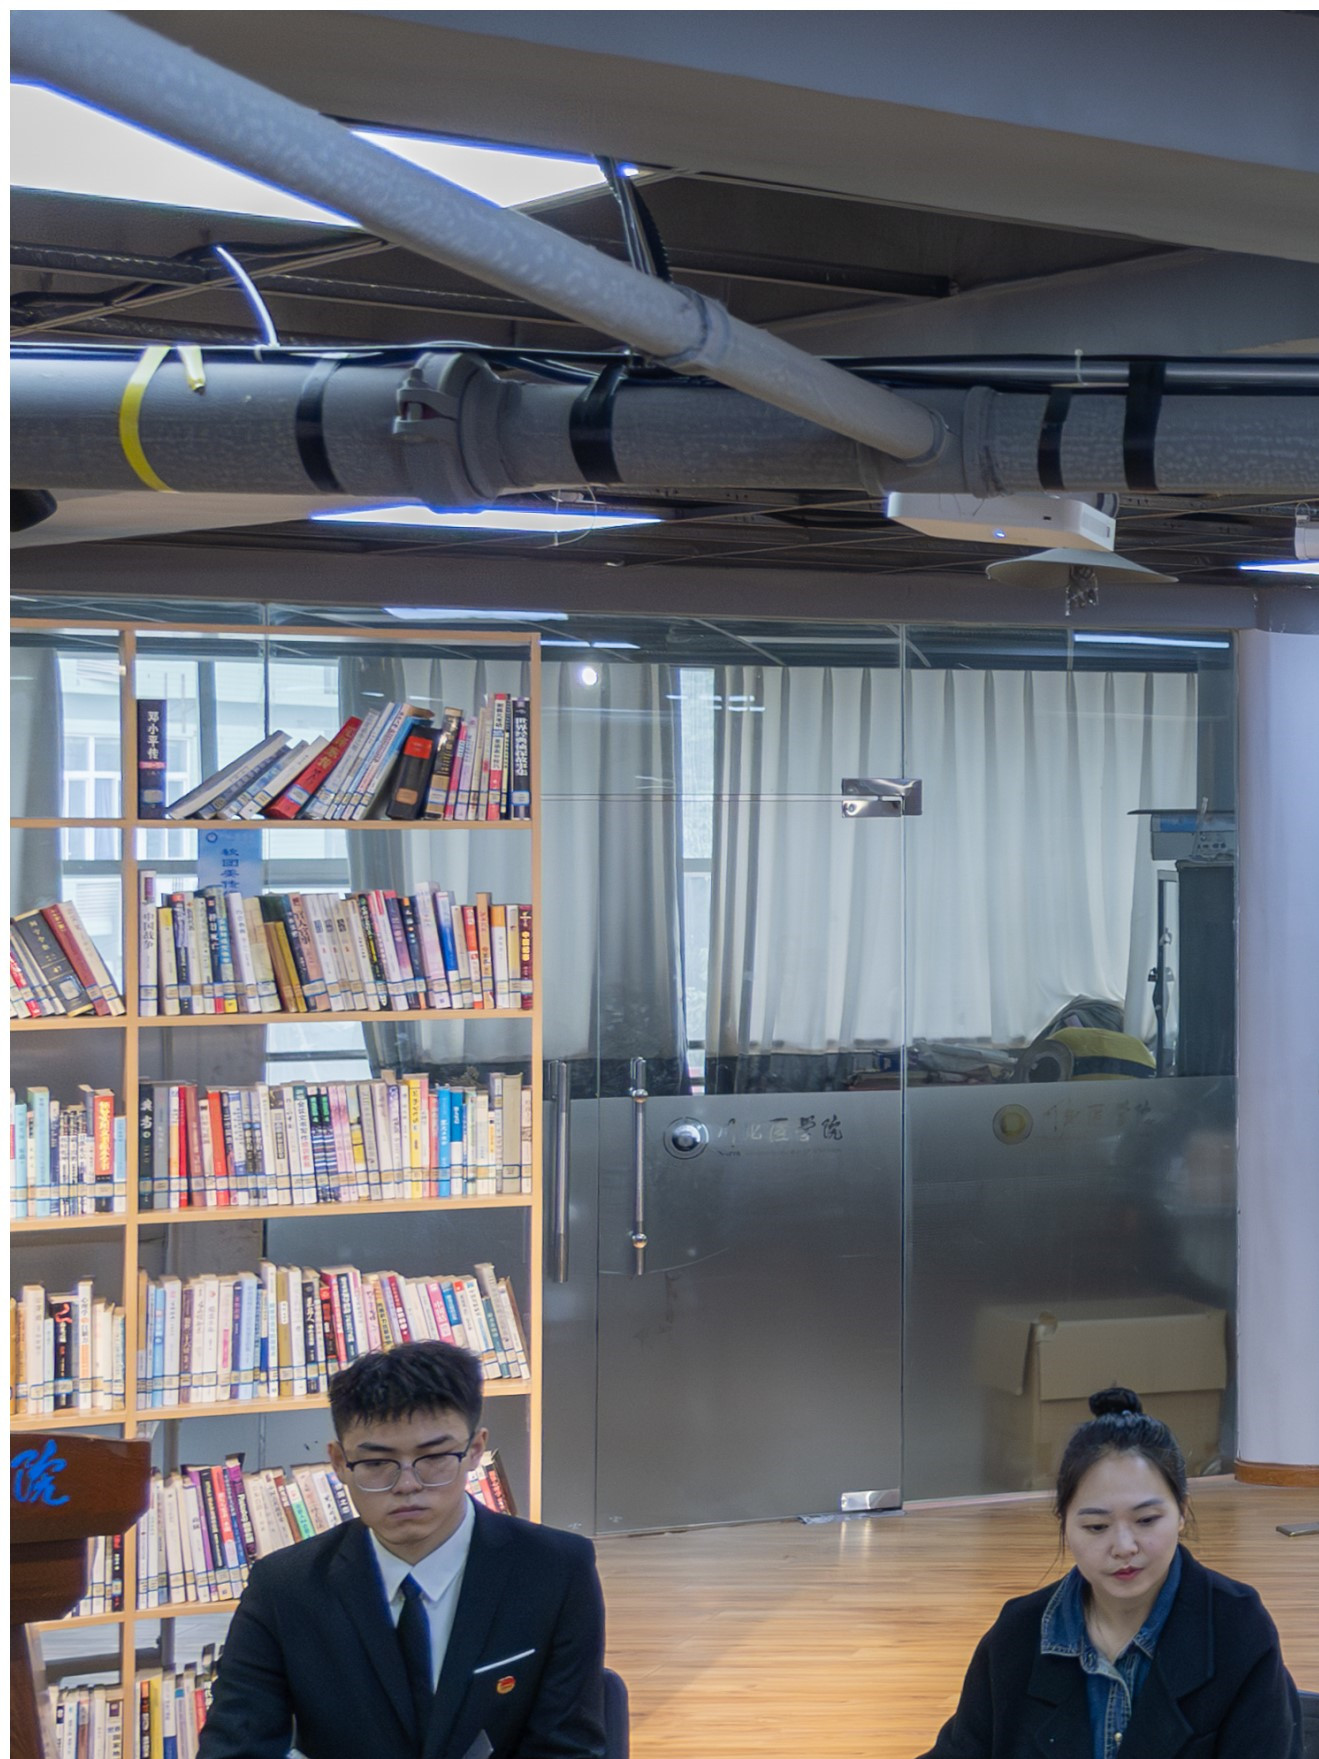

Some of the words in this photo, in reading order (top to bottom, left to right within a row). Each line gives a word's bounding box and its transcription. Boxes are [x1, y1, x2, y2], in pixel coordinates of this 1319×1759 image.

[147, 711, 160, 760] 邓小平传
[11, 1439, 71, 1506] 院
